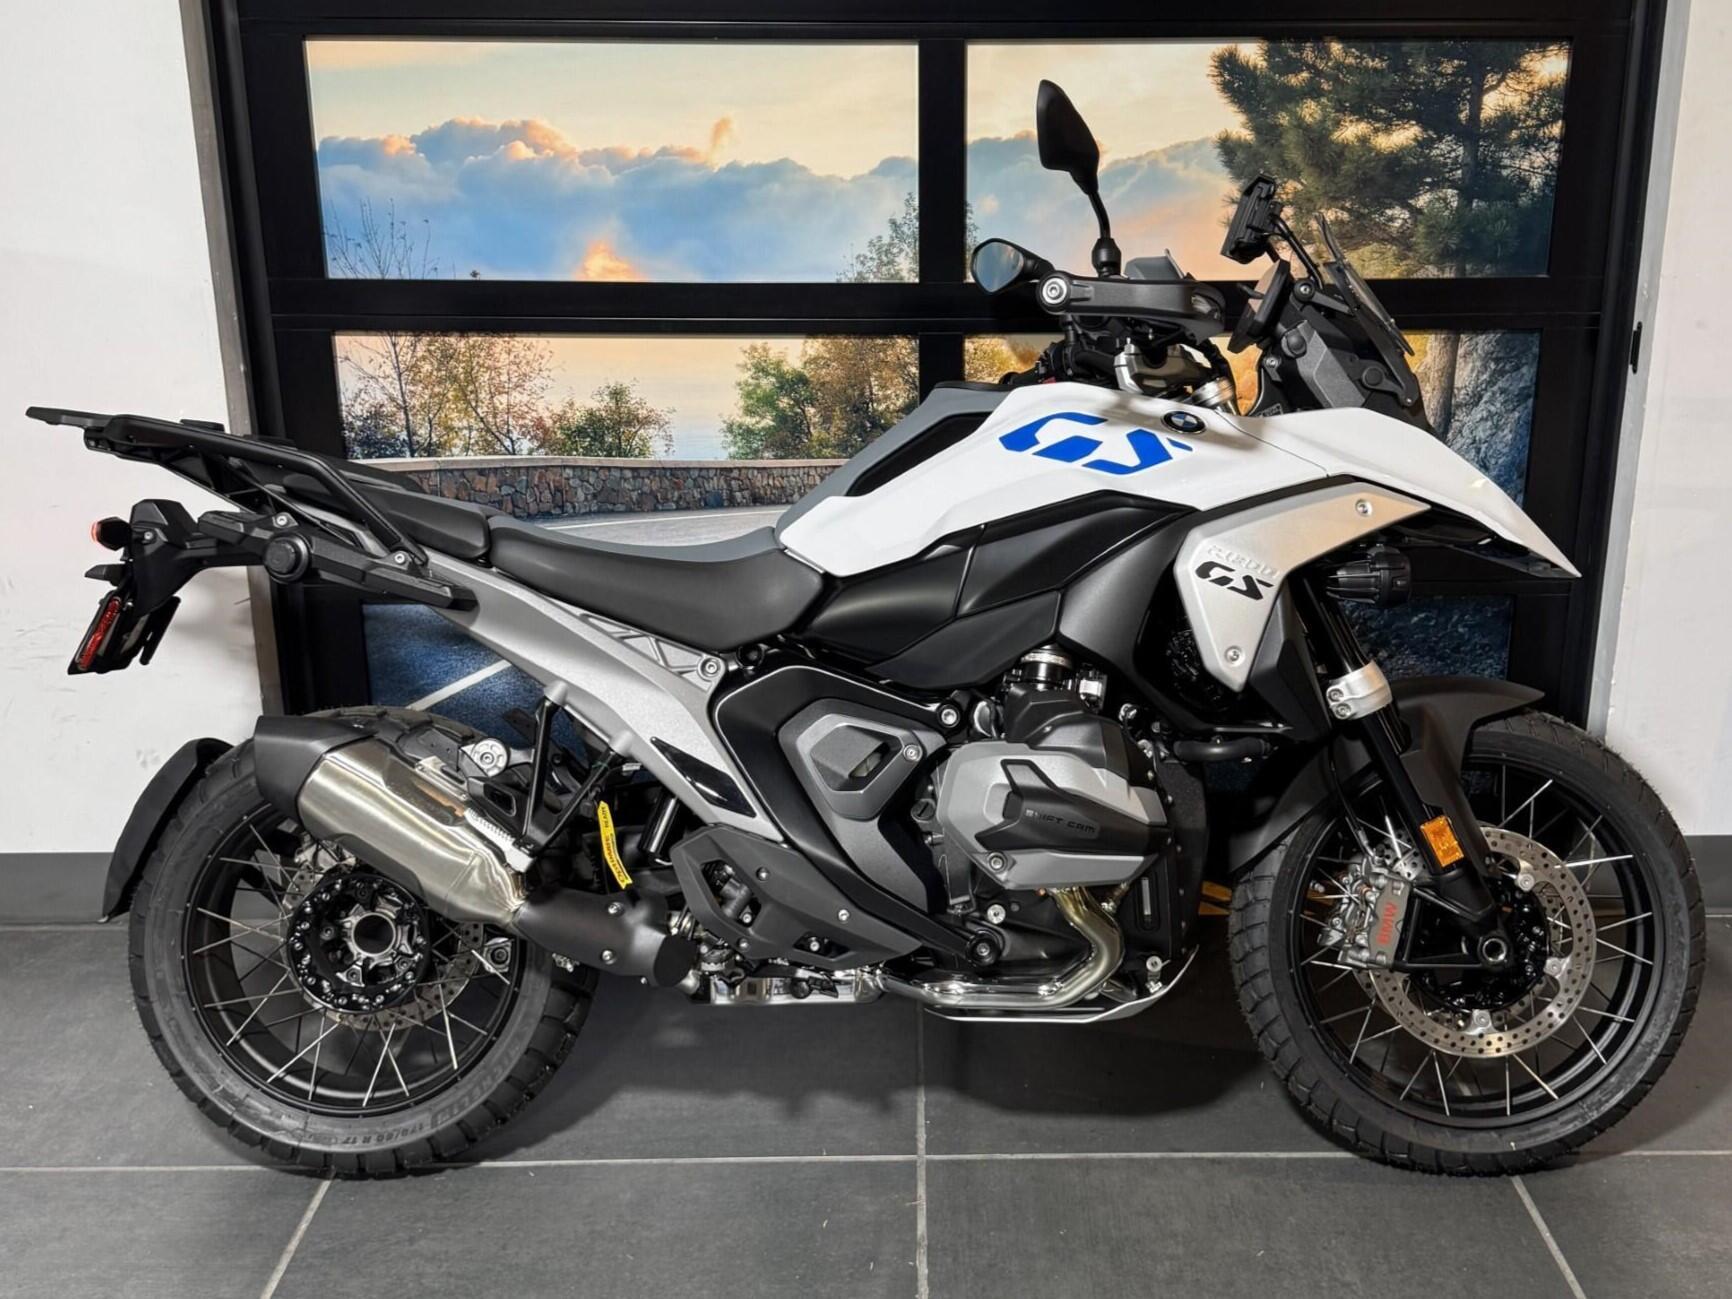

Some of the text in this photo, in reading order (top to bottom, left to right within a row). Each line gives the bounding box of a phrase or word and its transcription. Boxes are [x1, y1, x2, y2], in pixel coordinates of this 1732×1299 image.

[998, 411, 1194, 476] GS
[1195, 560, 1275, 601] GS
[1377, 902, 1396, 944] BMW
